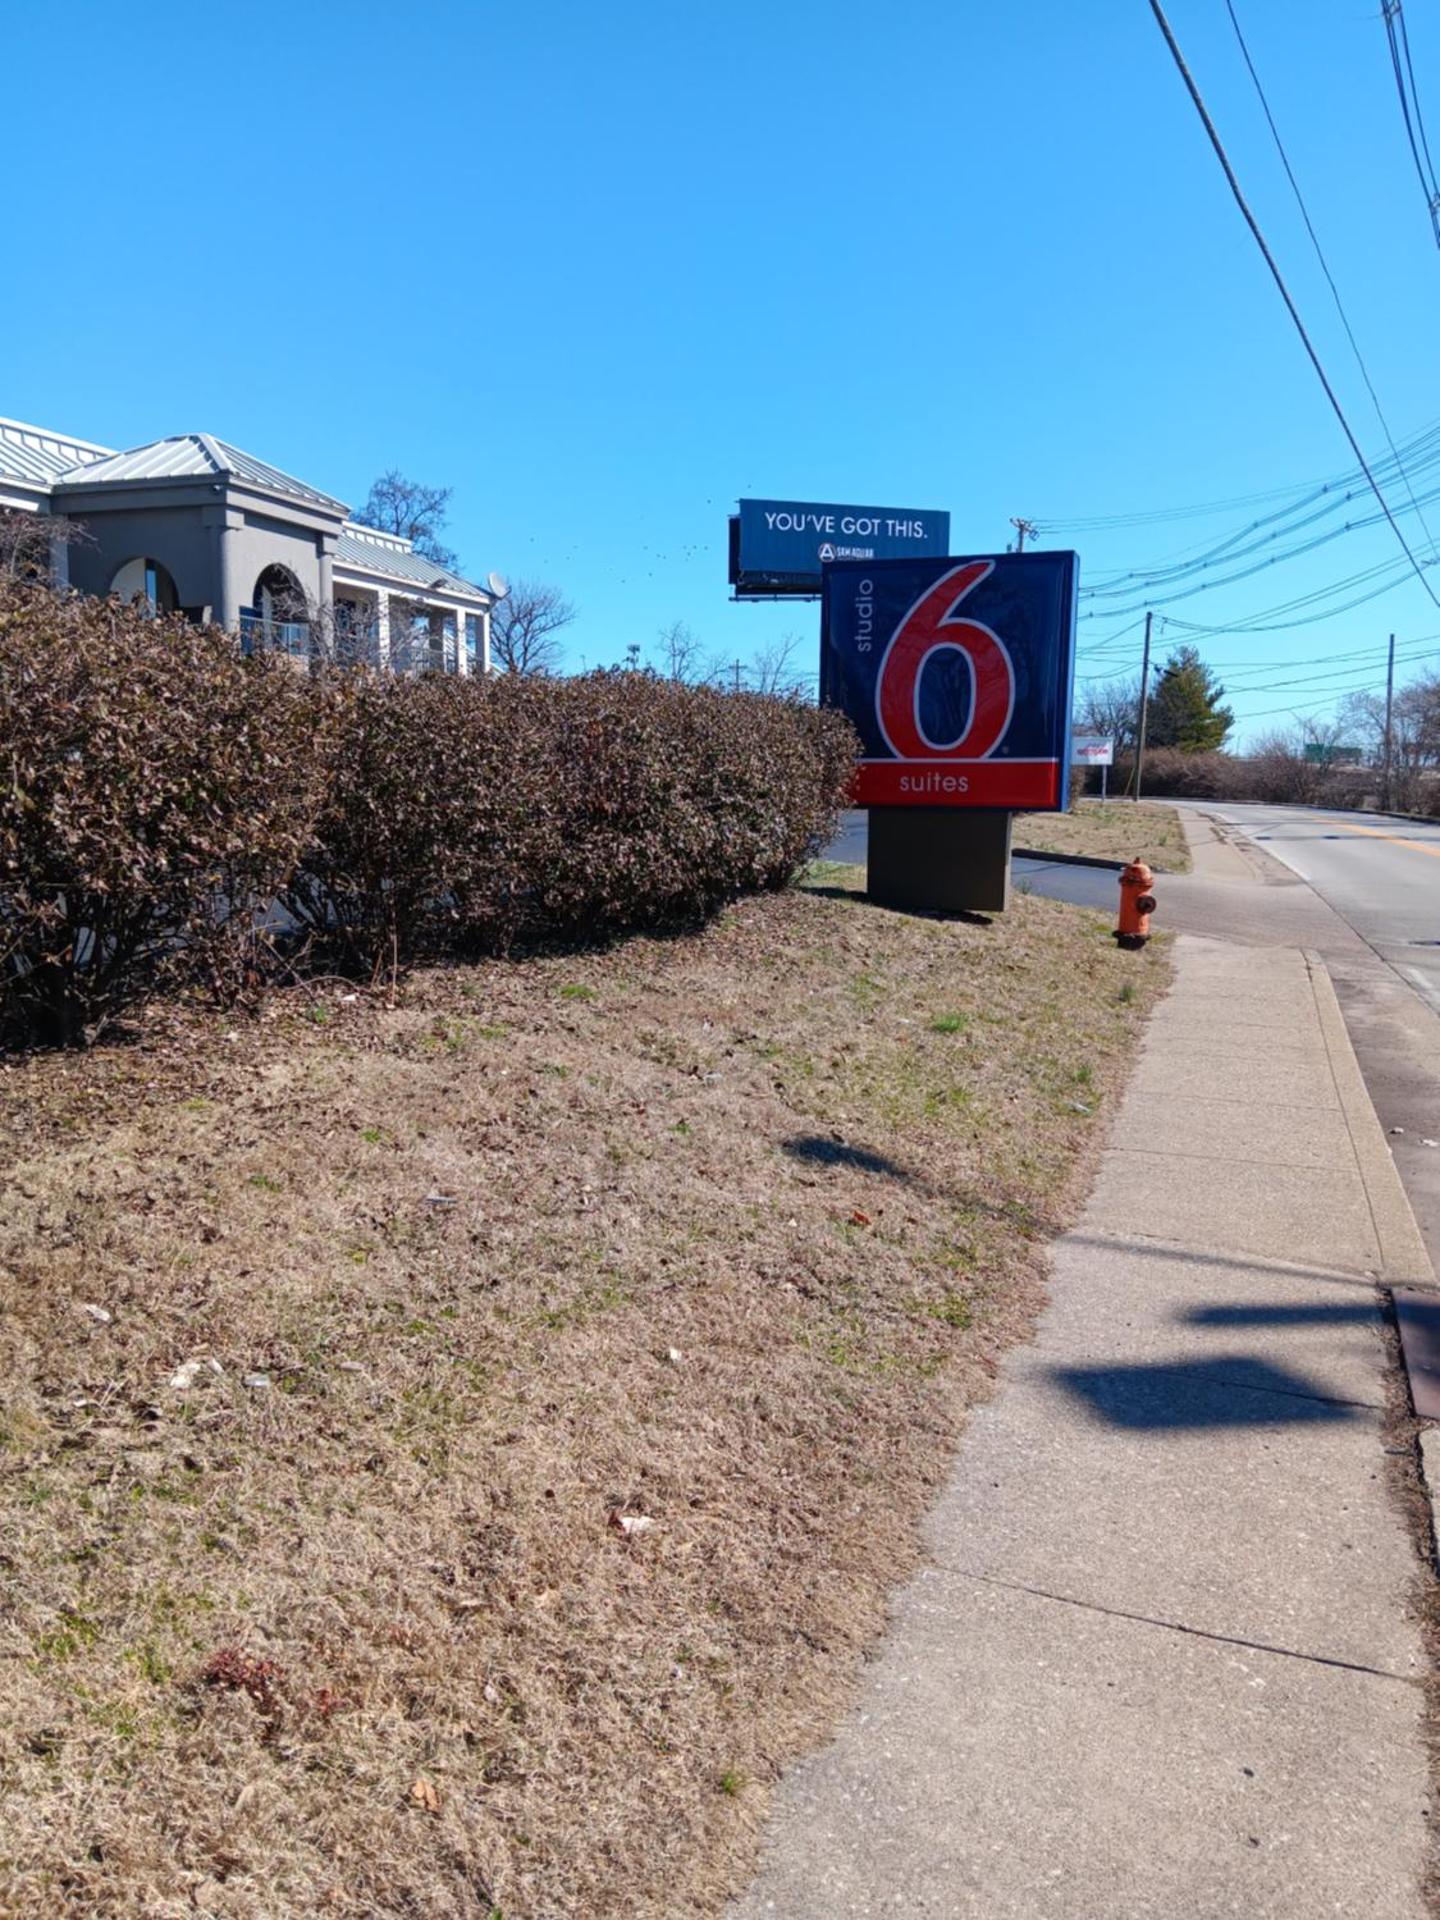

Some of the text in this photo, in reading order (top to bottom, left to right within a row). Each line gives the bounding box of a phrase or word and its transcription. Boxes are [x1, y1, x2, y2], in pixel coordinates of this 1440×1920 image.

[764, 512, 928, 539] YOU'VE GOT THIS.
[855, 579, 874, 653] studio
[875, 559, 1015, 759] 6
[899, 772, 969, 792] suites
